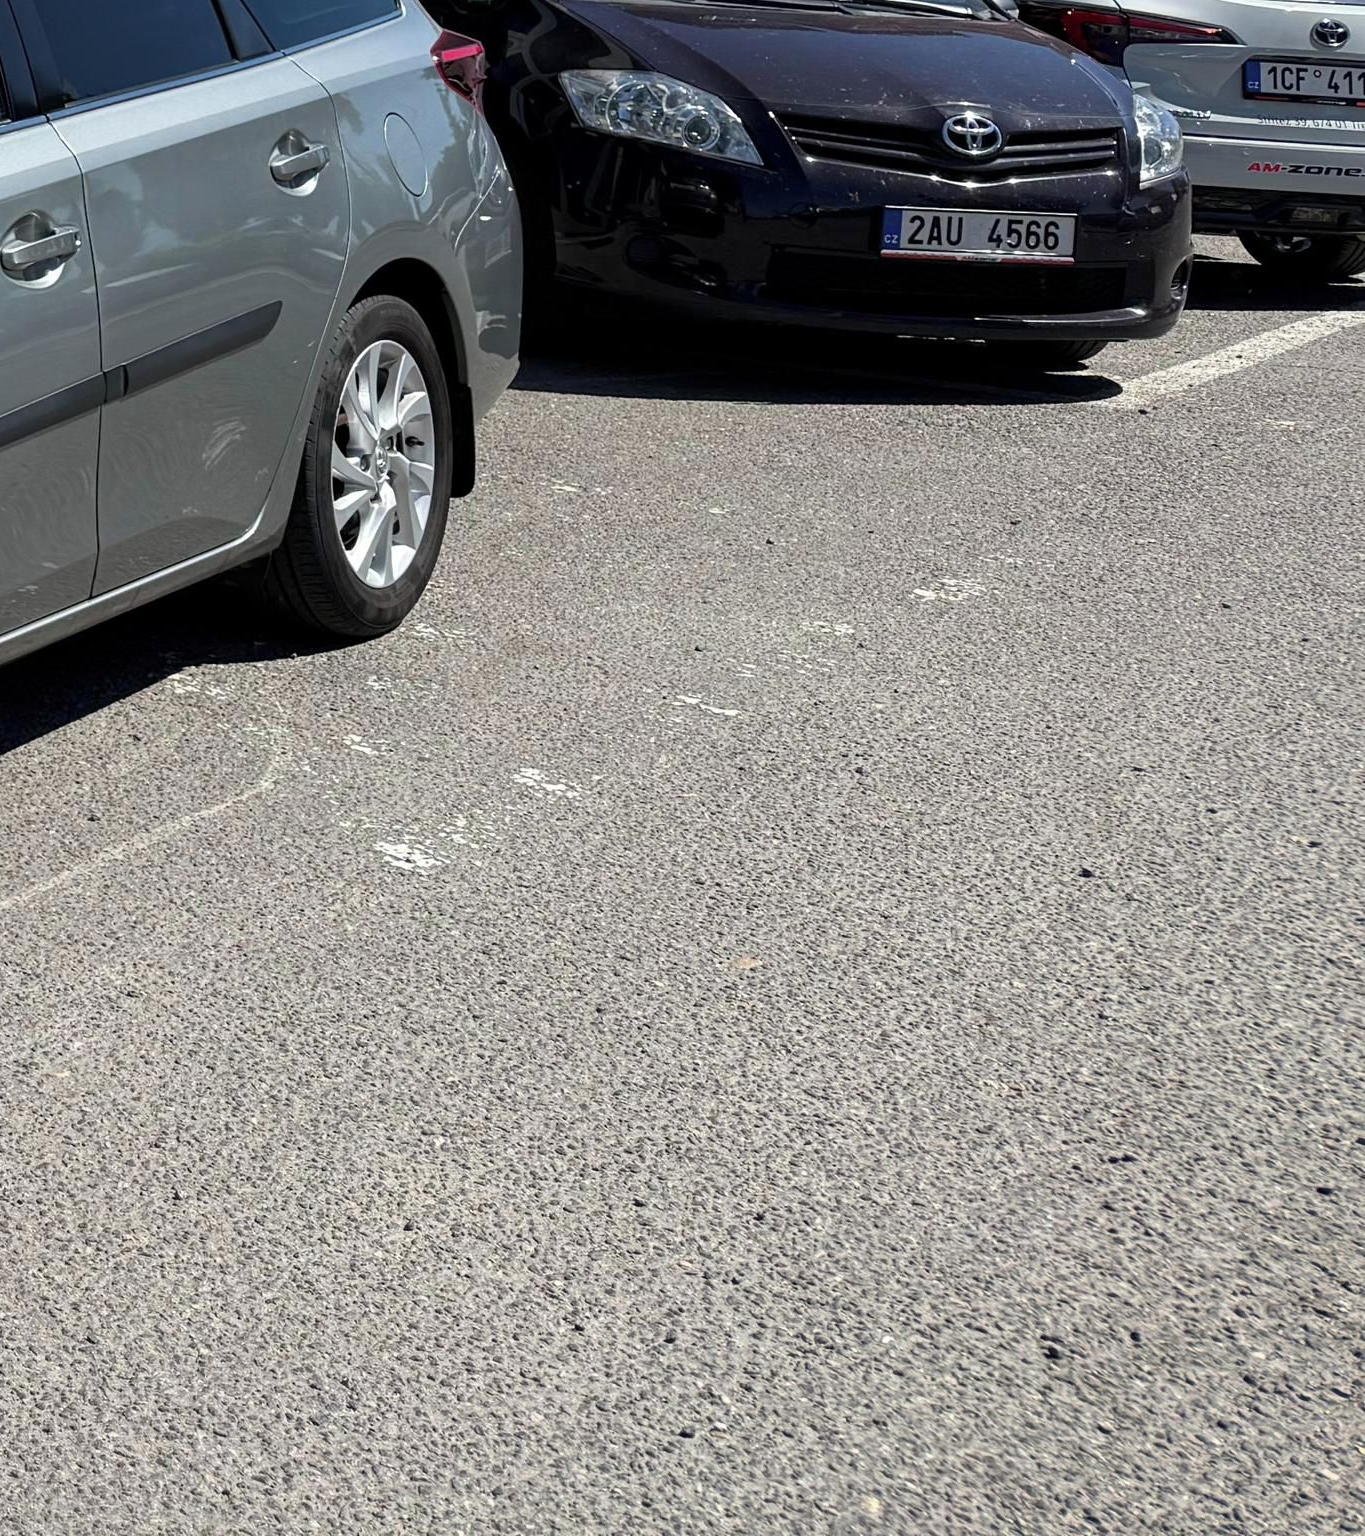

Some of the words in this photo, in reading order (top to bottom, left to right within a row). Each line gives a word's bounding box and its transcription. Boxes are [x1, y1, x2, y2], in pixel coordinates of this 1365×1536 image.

[1267, 66, 1308, 91] 1CF
[884, 234, 898, 244] CZ
[907, 215, 963, 246] 2AU
[987, 218, 1060, 250] 4566
